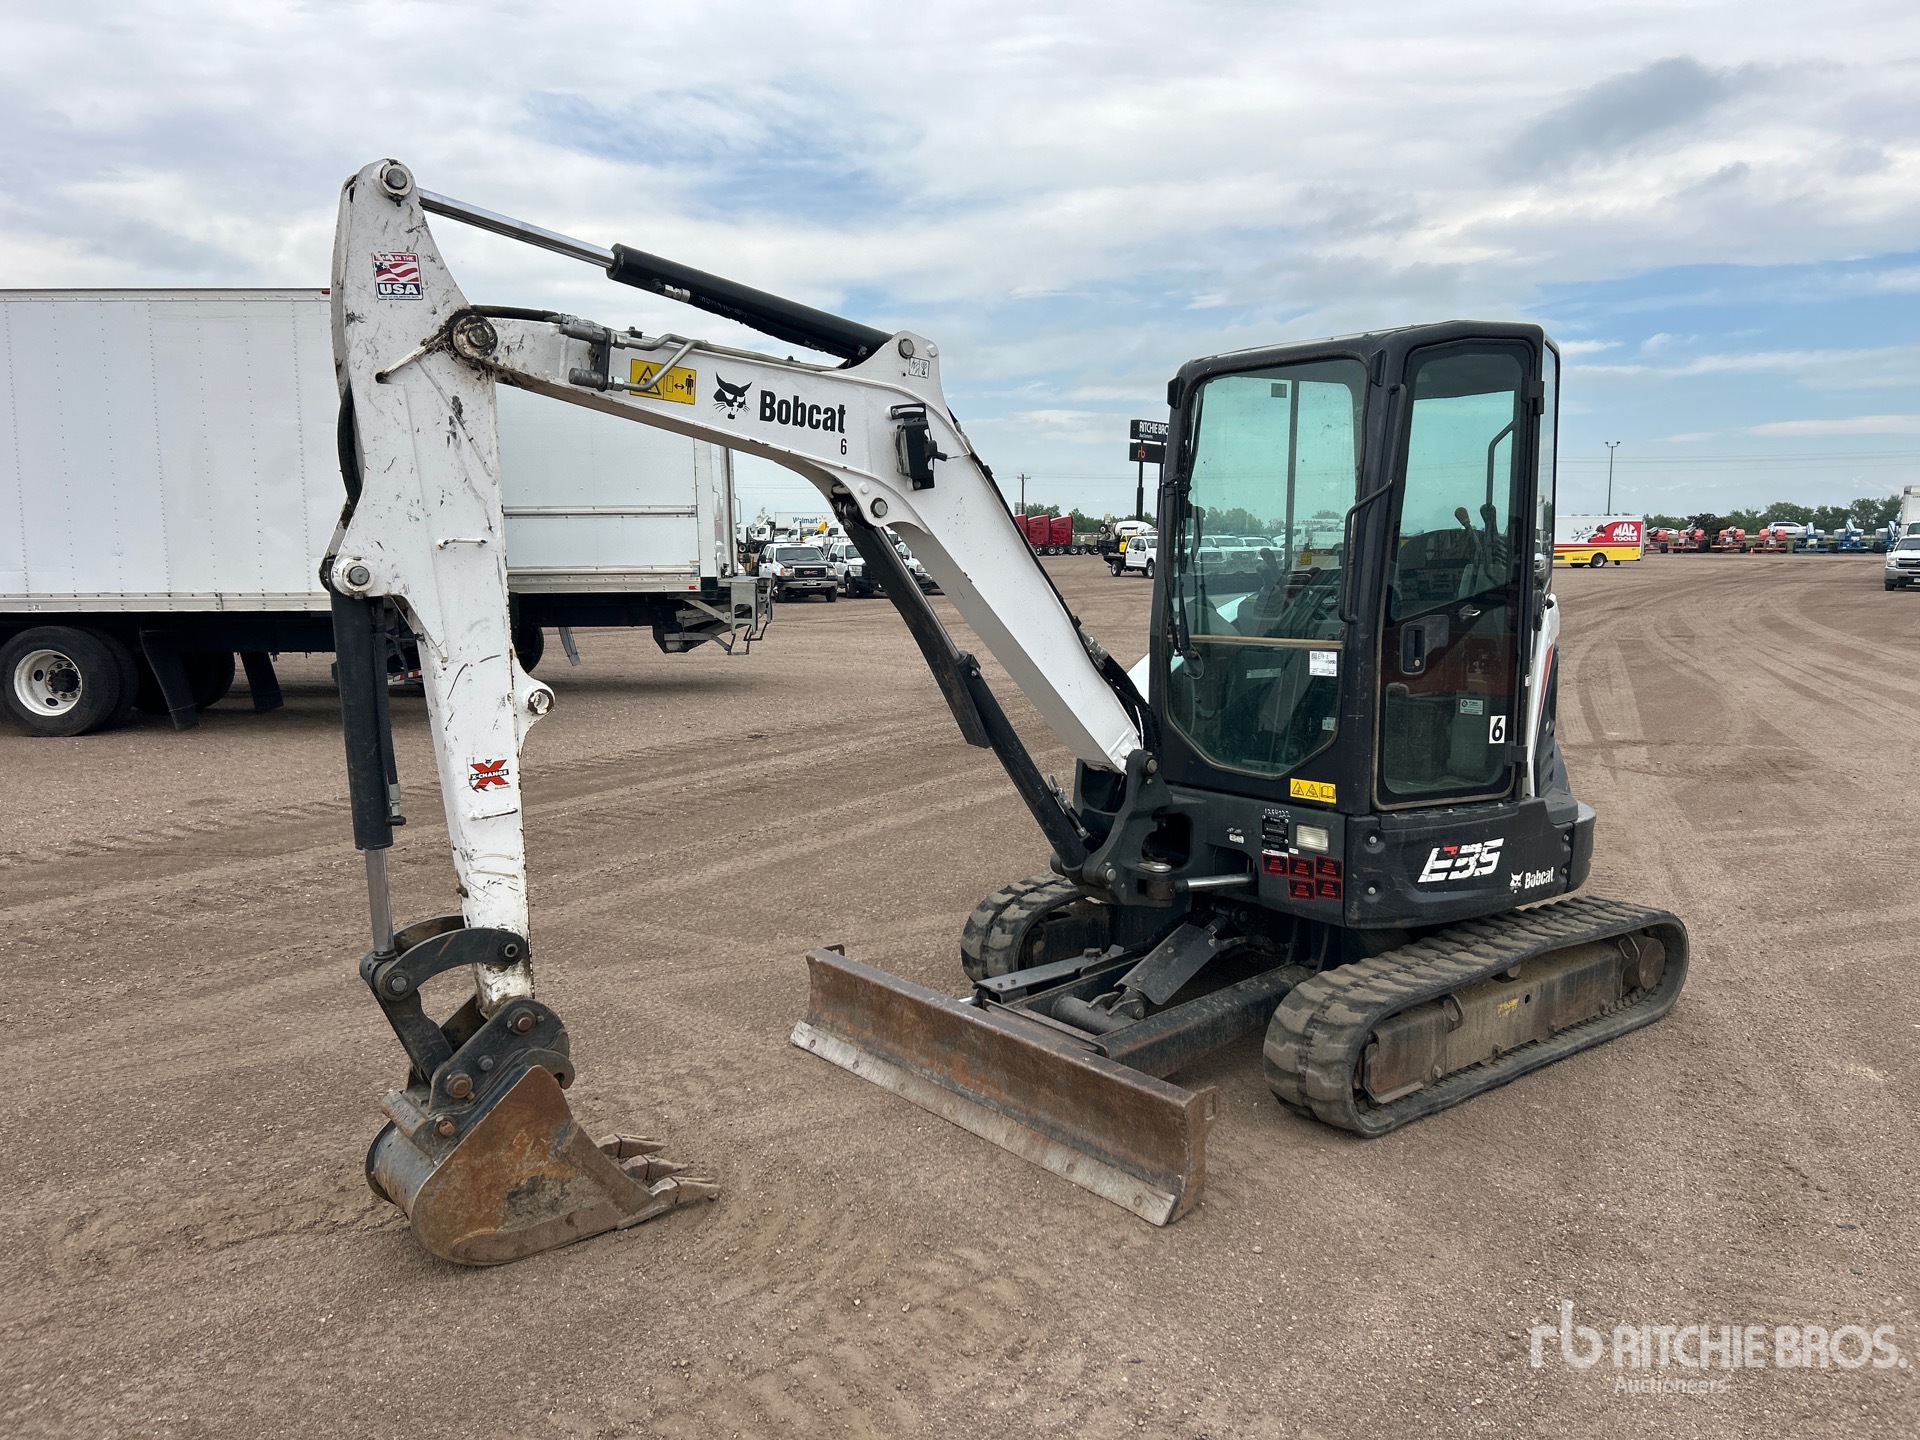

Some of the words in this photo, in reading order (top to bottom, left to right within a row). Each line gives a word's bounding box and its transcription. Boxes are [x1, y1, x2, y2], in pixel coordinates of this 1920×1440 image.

[379, 283, 419, 295] USA
[760, 390, 846, 434] Bobcat
[1139, 421, 1158, 434] RITCHIE
[840, 438, 848, 455] 6
[1612, 523, 1638, 536] MAC
[1491, 717, 1504, 742] 6
[471, 769, 508, 780] X-CHANGE
[1417, 838, 1505, 883] E35
[1524, 867, 1555, 890] Bobcat
